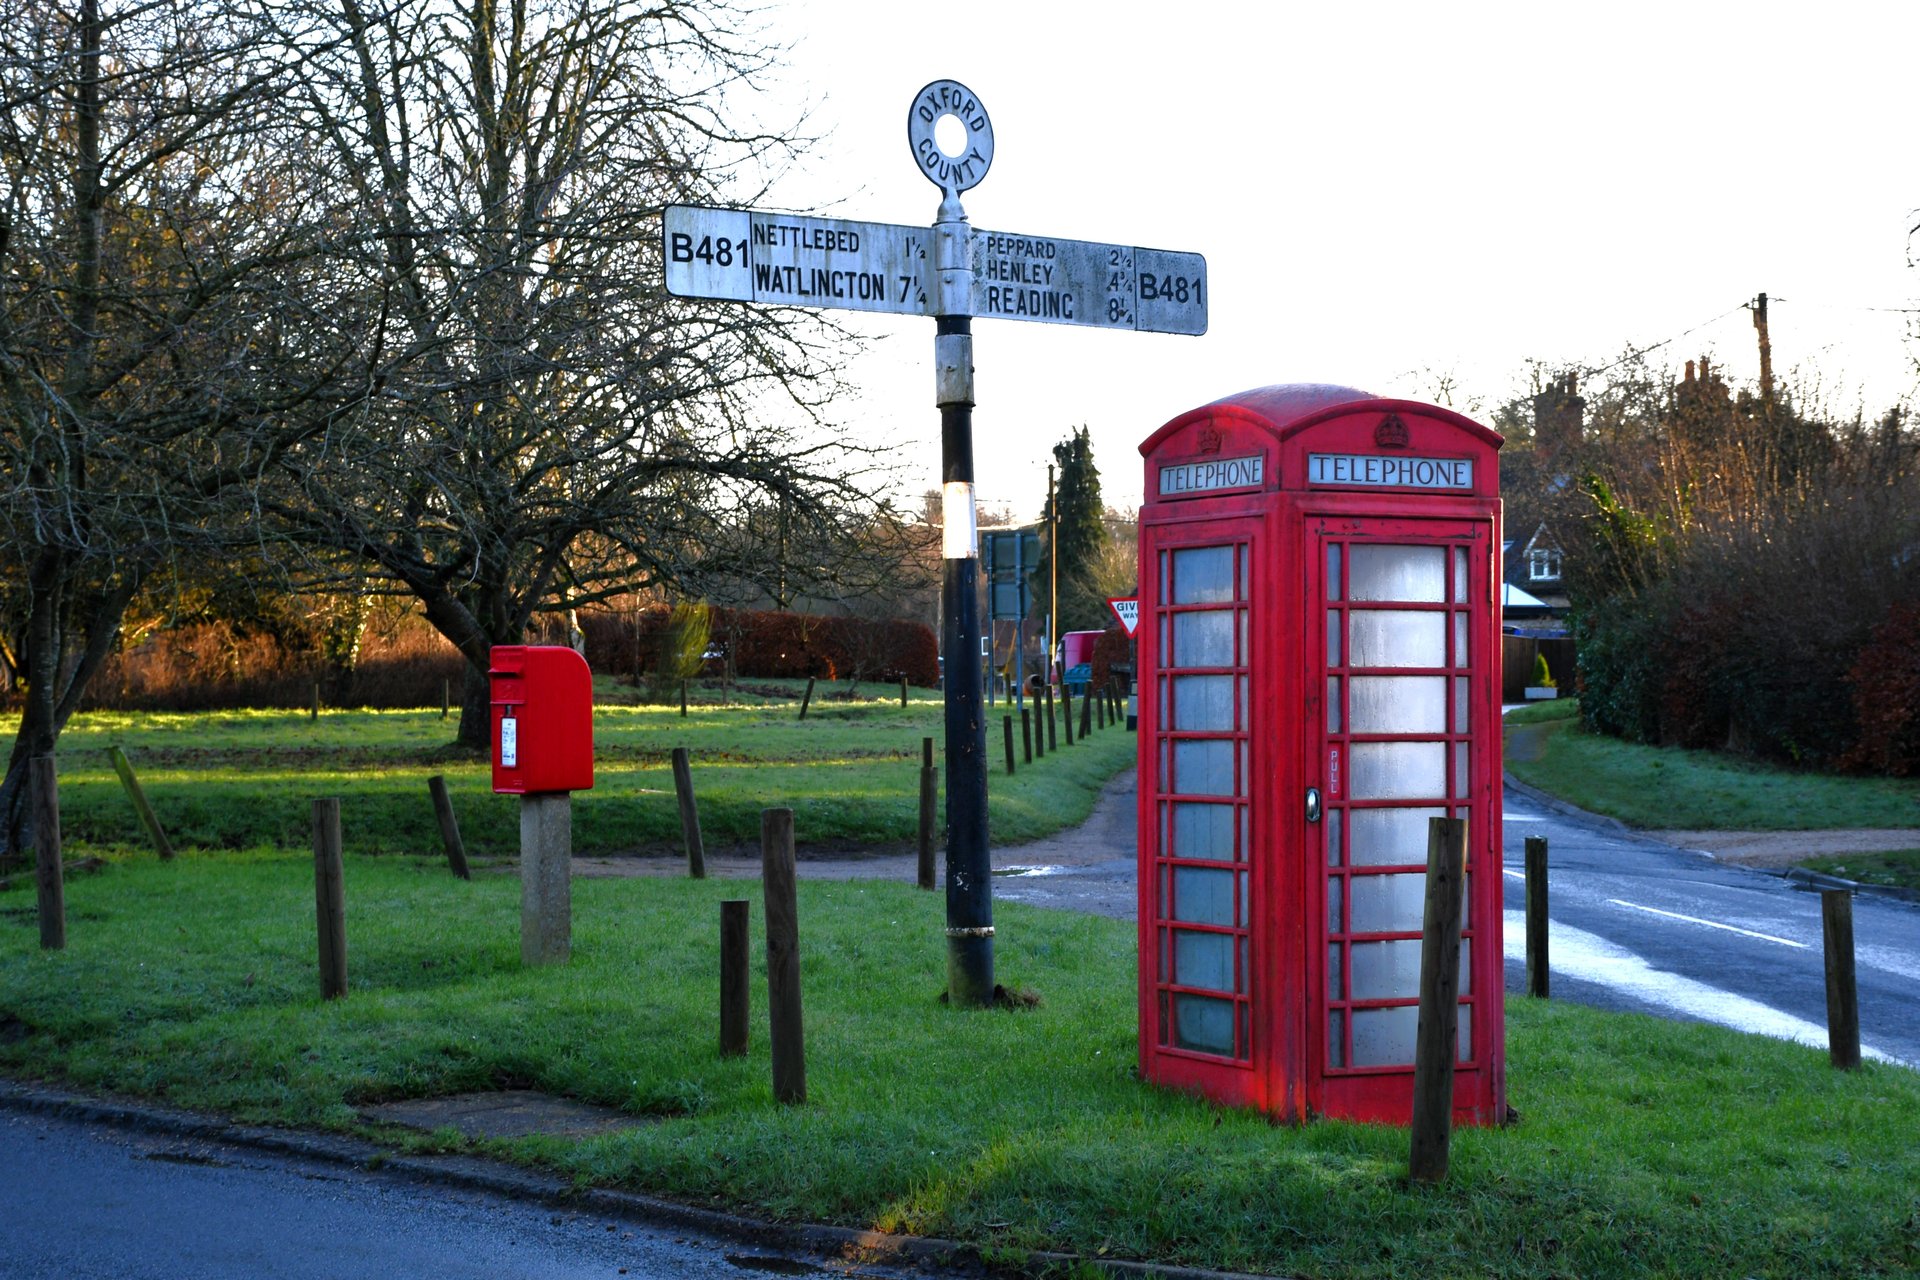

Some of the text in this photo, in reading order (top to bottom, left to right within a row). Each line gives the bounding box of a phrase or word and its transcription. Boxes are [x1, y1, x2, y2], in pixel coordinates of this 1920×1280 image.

[919, 87, 985, 132] OXFORD
[919, 138, 985, 184] COUNTY
[671, 232, 748, 268] B481
[754, 223, 860, 253] NETTLEBED
[987, 236, 1056, 259] PEPPARD
[756, 263, 884, 301] WATLINGTON
[988, 260, 1053, 285] HENLEY
[988, 286, 1073, 319] READING
[1140, 273, 1202, 305] B481
[1164, 459, 1261, 491] TELEPHONE
[1313, 456, 1466, 486] TELEPHONE
[1116, 602, 1138, 611] GIV
